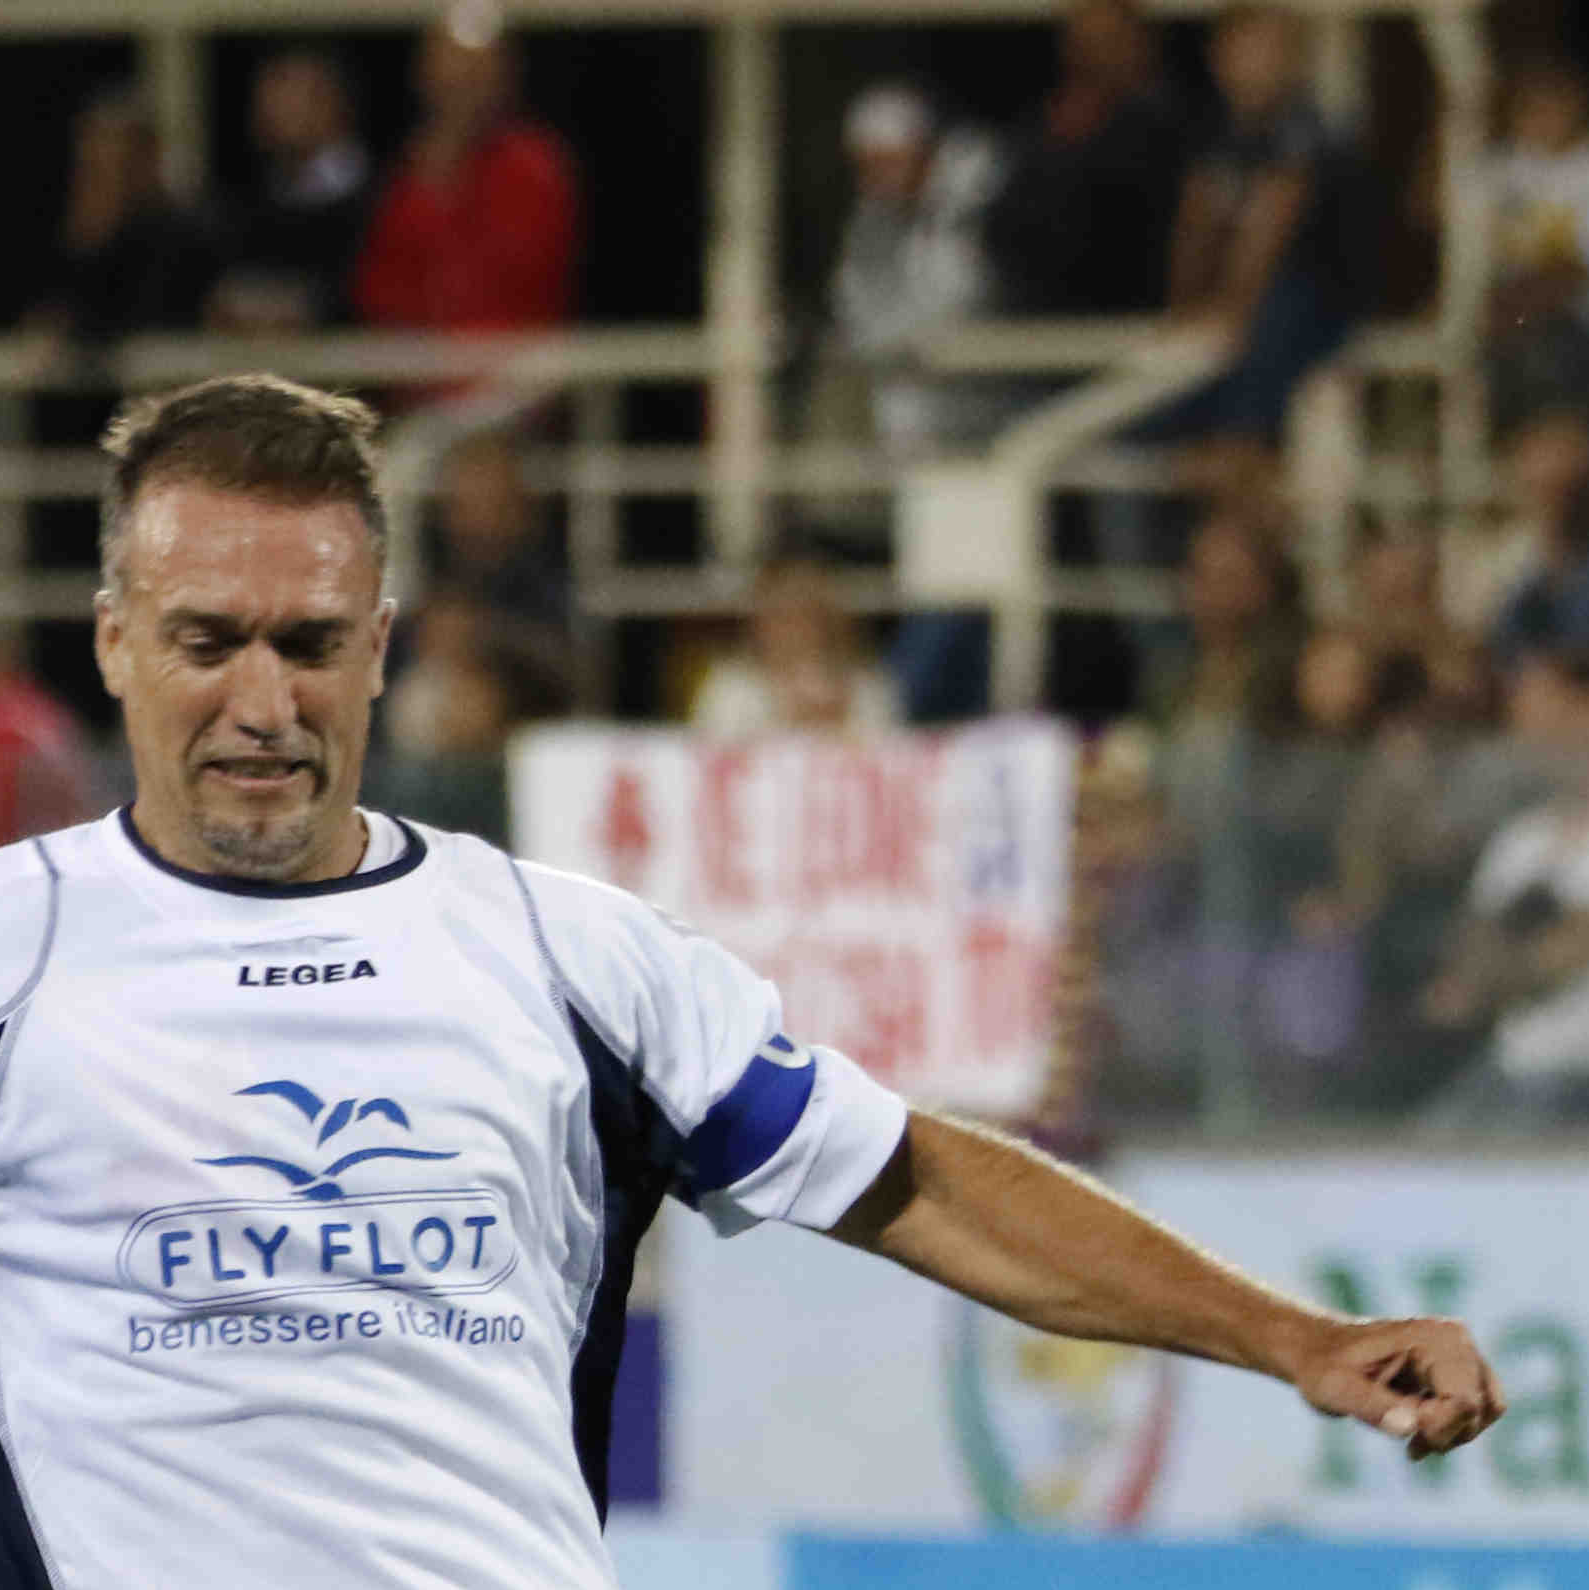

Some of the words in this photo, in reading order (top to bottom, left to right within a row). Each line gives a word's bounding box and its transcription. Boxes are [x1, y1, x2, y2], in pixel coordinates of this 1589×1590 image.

[237, 959, 378, 987] LEGEA
[159, 1224, 288, 1287] FLY
[320, 1215, 496, 1276] FLOT
[128, 1310, 382, 1353] benessere
[395, 1301, 525, 1345] italiano
